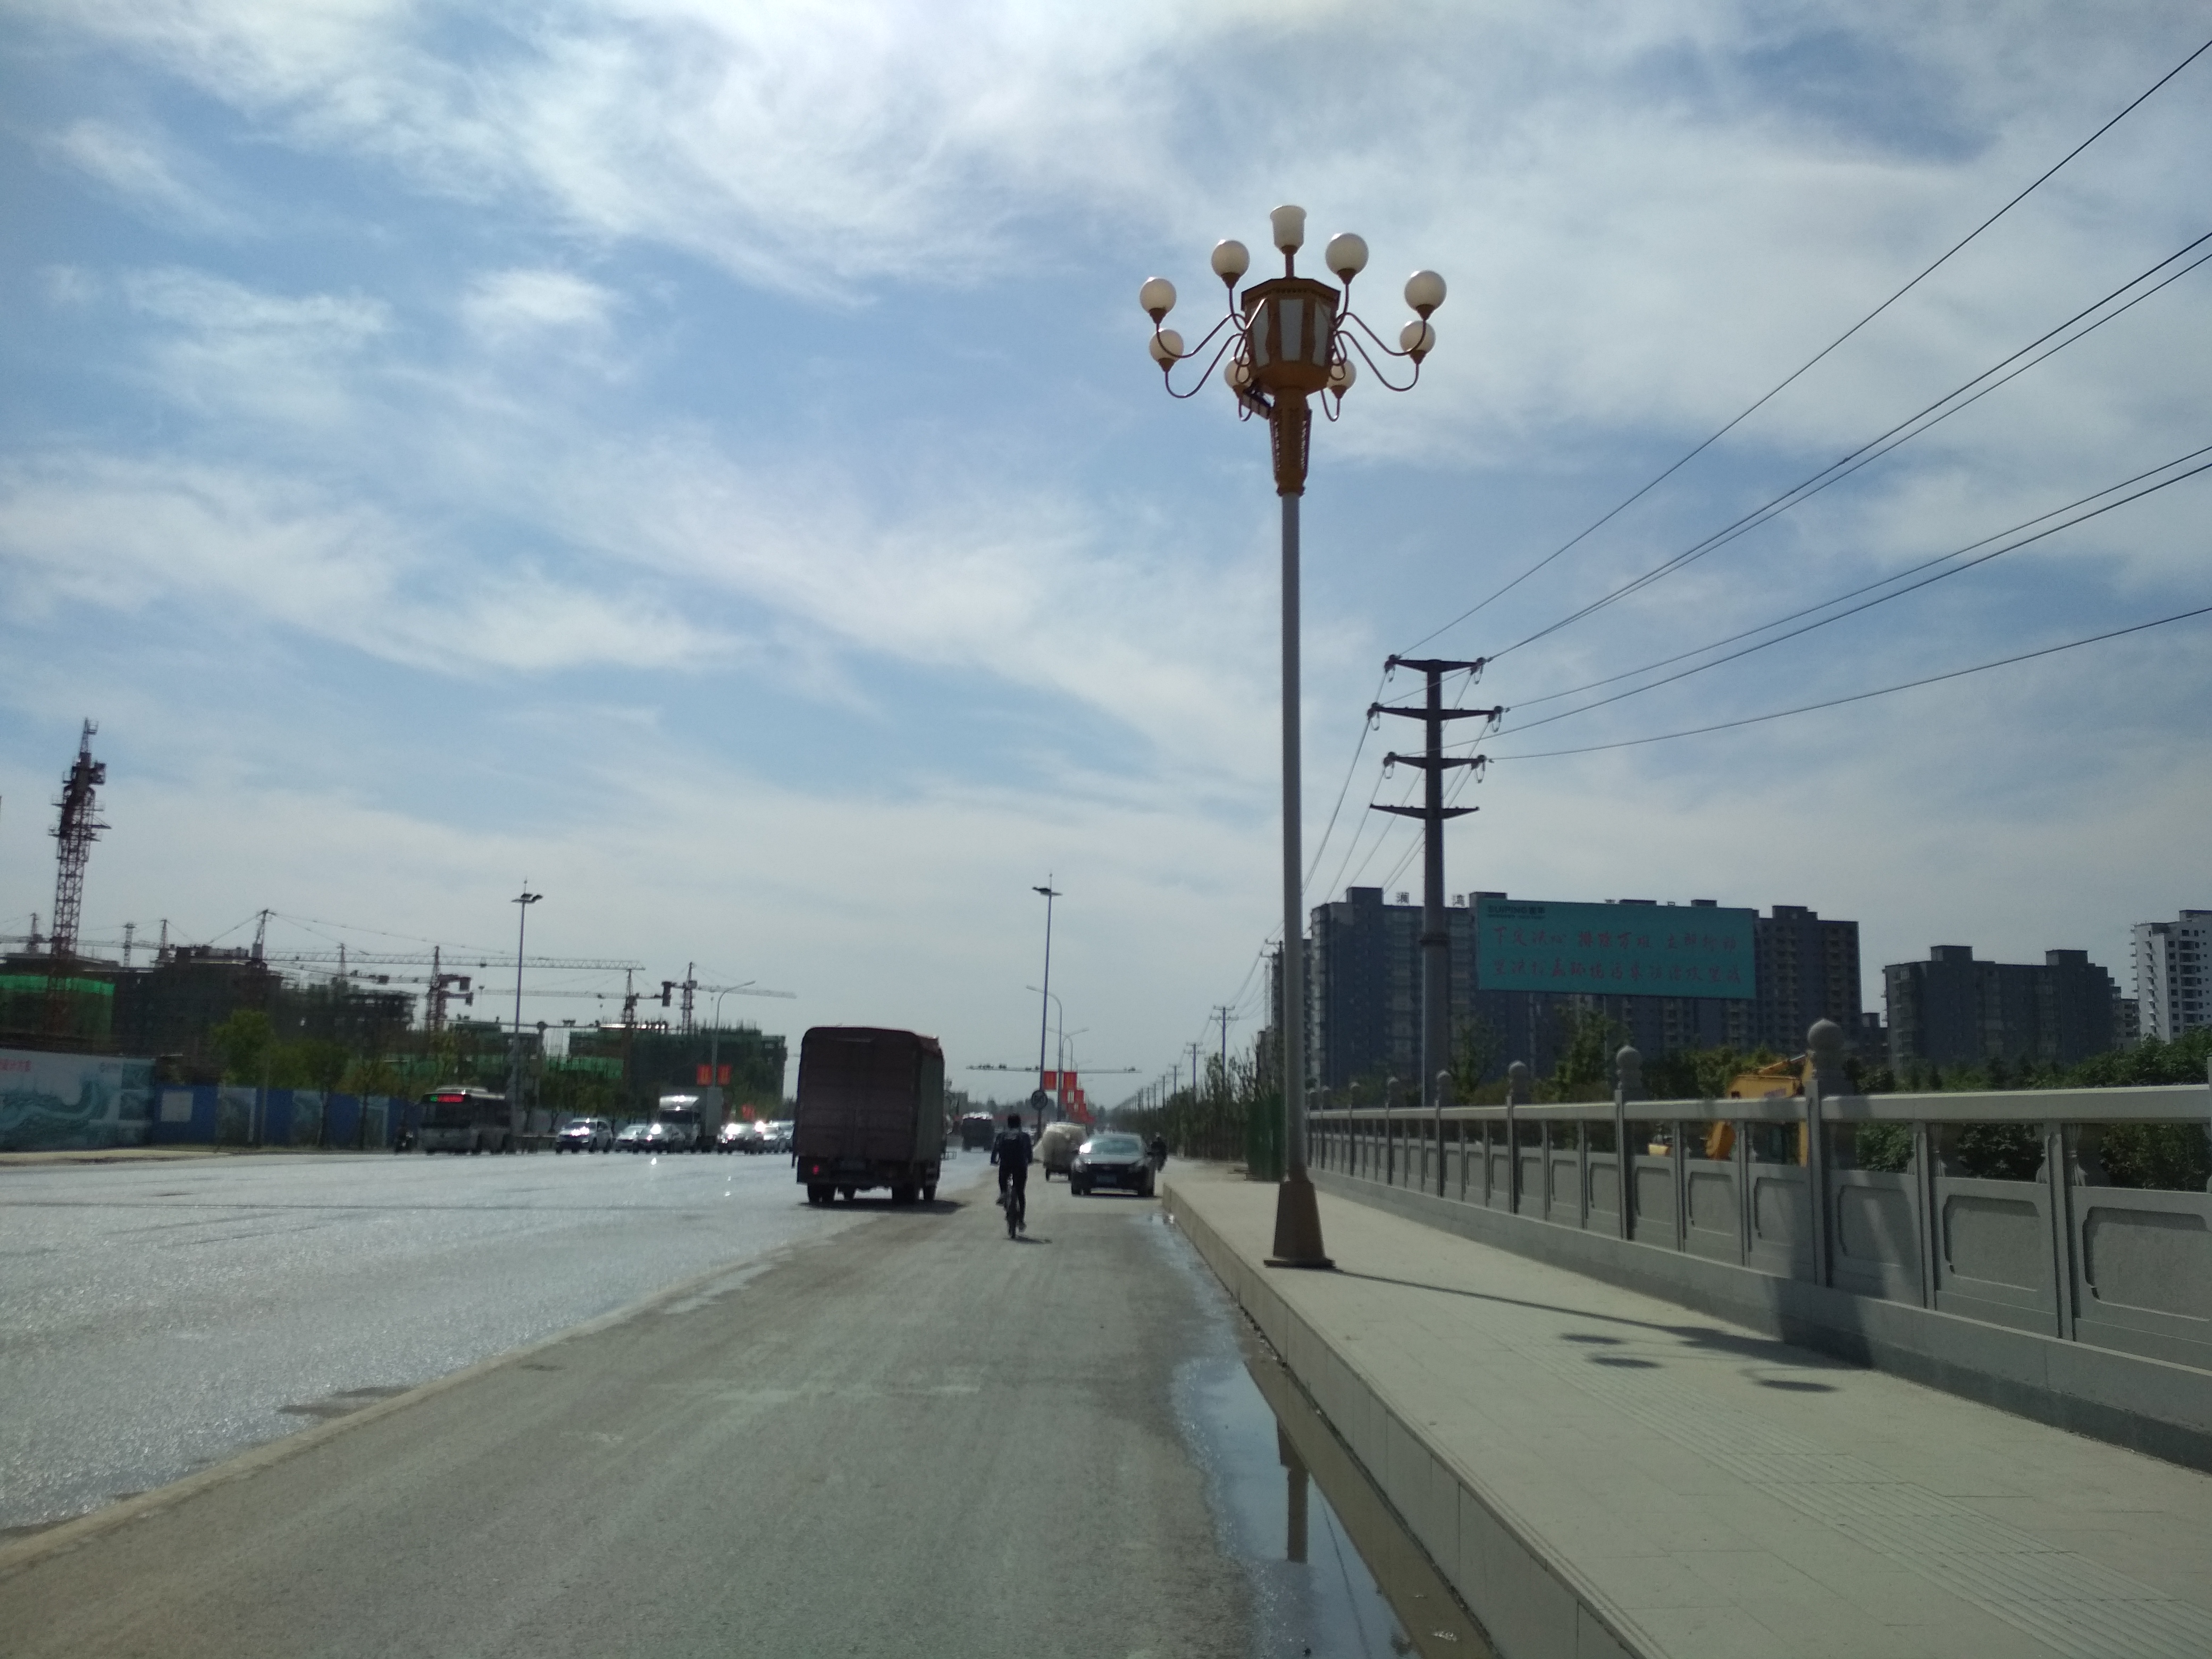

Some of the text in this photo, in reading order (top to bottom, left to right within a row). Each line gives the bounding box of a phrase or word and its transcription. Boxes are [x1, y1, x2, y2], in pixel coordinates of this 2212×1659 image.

[1493, 925, 1566, 947] 下定决心
[1578, 931, 1652, 949] 排除万难
